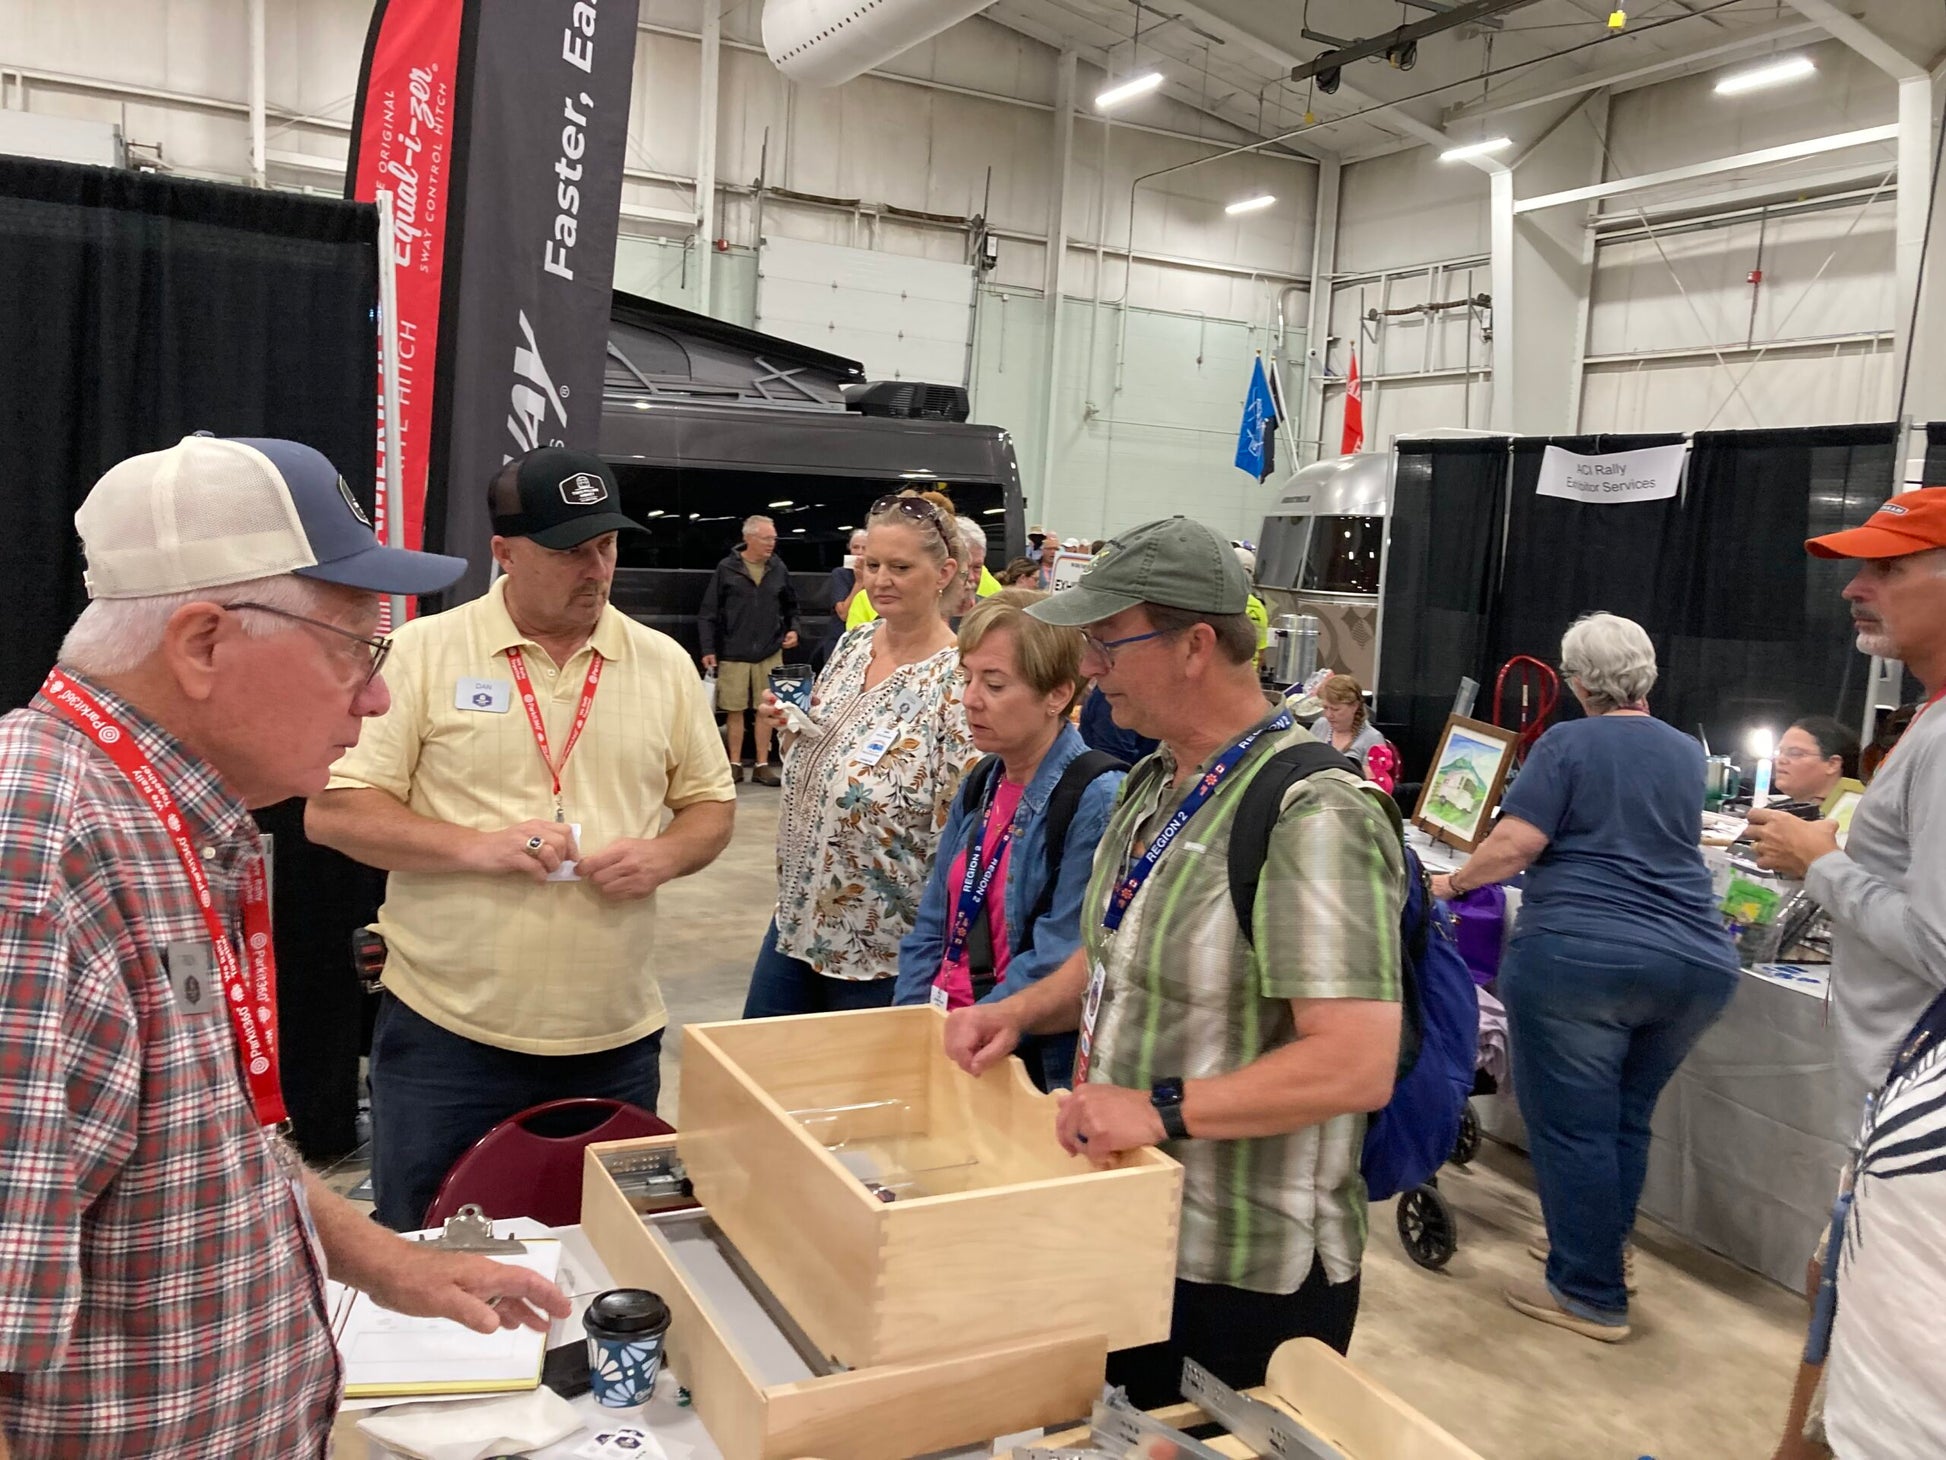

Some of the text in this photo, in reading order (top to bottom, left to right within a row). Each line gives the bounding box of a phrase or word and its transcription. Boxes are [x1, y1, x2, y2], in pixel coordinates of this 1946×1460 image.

[378, 90, 395, 173] ORIGINAL
[543, 0, 597, 280] Faster, Ea
[420, 82, 447, 273] SWAY CONTROL HITCH
[1595, 463, 1627, 476] Rally
[1602, 479, 1656, 493] Services
[1146, 811, 1189, 863] REGION 2
[962, 853, 980, 892] REGION
[975, 858, 998, 895] REGION
